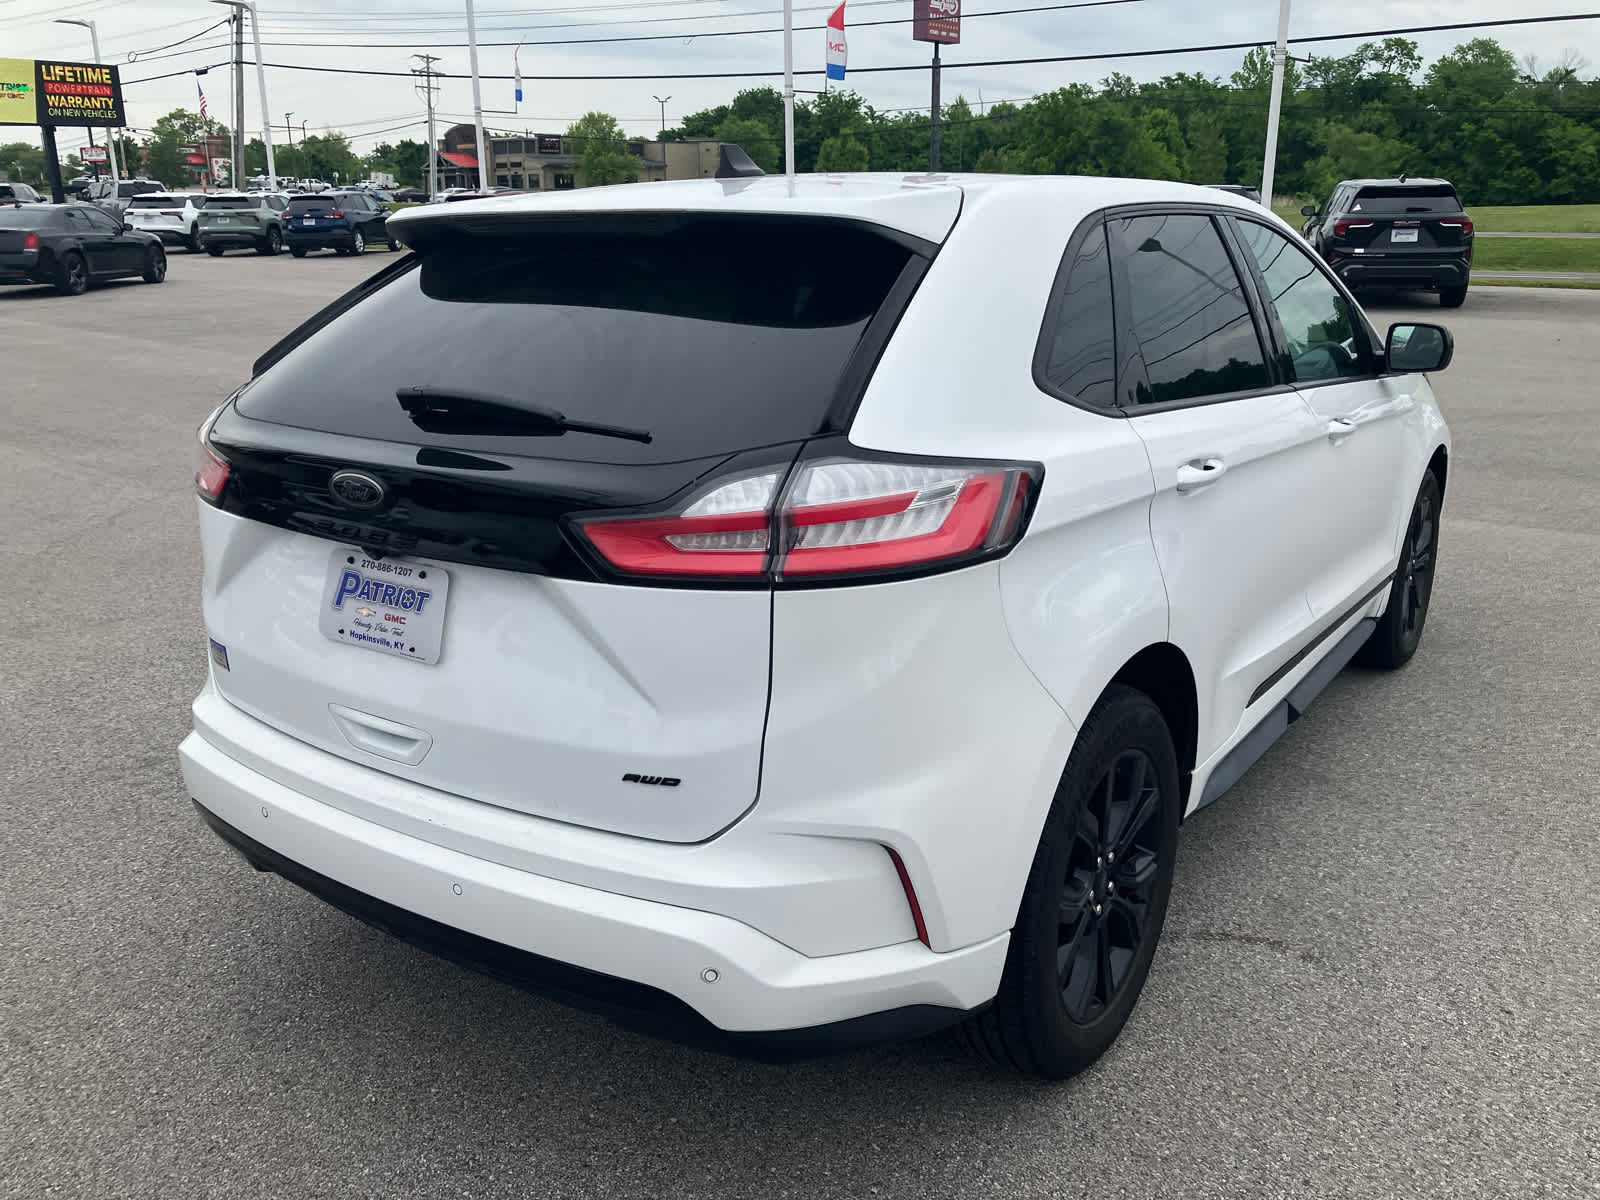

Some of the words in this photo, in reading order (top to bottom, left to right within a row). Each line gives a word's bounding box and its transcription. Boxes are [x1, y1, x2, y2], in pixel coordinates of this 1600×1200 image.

[41, 64, 112, 84] LIFETIME
[48, 84, 110, 95] POWERTRAIN
[46, 94, 114, 109] WARRANTY
[48, 108, 61, 116] ON
[63, 109, 81, 117] NEW
[82, 109, 117, 119] VEHICLES
[361, 559, 413, 577] 270-886-1207
[334, 569, 431, 613] PATRIOT
[384, 613, 406, 625] GMC
[349, 629, 392, 648] Hopkinsville,
[394, 641, 406, 650] KY
